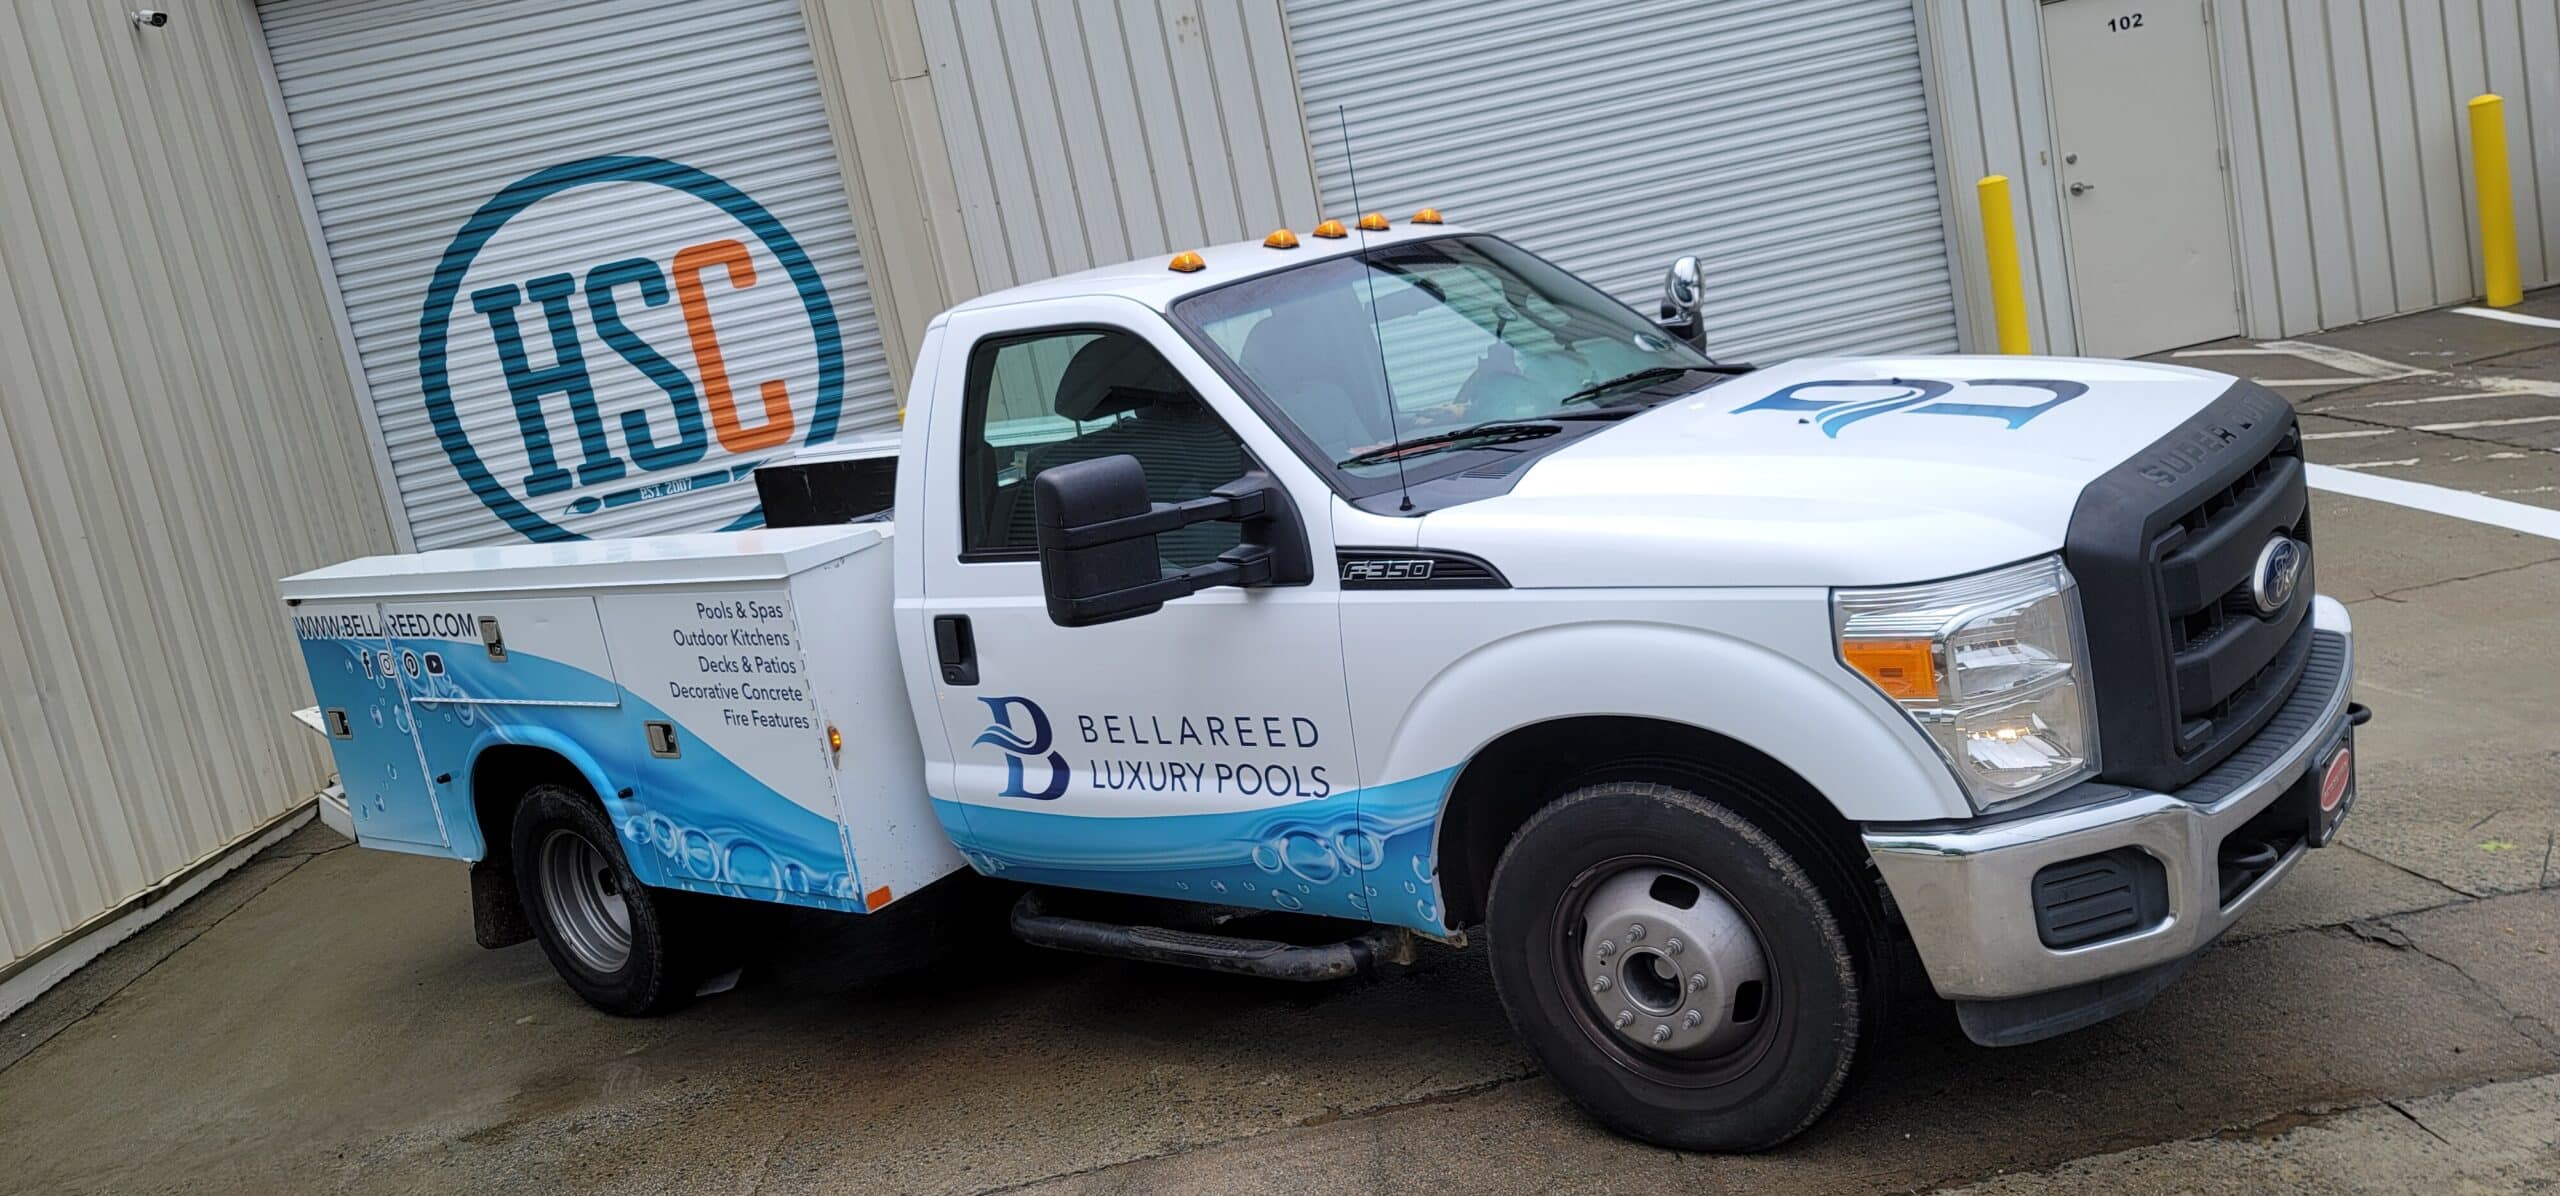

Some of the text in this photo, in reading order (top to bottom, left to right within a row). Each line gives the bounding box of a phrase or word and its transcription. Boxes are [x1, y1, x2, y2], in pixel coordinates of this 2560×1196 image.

[2107, 13, 2144, 33] 102
[471, 239, 795, 497] HSC
[666, 478, 693, 495] 2007
[696, 600, 783, 624] Pools & Spas
[673, 627, 790, 647] Outdoor Kitchens
[698, 655, 797, 674] Decks & Patios
[669, 681, 803, 701] Decorative Concrete
[723, 708, 810, 729] Fire Features
[1077, 714, 1319, 748] BELLAREED
[1090, 759, 1331, 799] LUXURY POOLS
